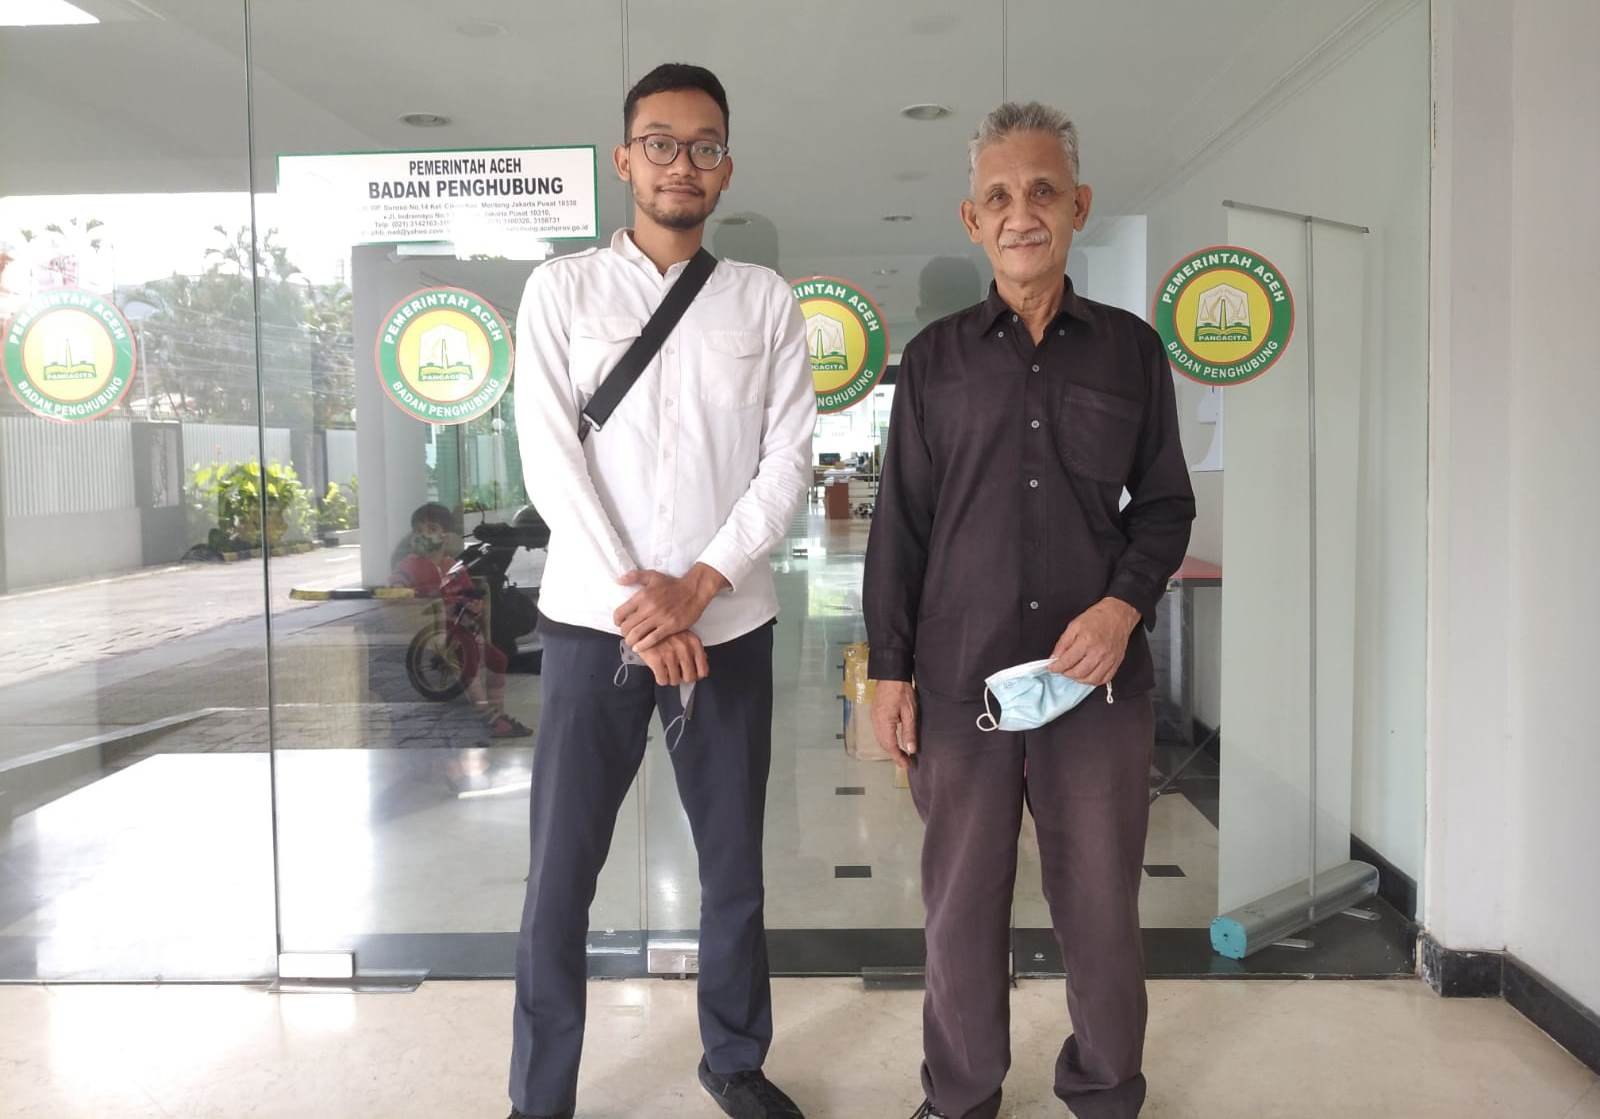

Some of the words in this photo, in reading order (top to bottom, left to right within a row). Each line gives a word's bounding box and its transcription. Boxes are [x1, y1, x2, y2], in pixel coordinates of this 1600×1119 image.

[409, 158, 487, 176] PEMERINTAH
[489, 157, 522, 174] ACEH
[368, 180, 431, 199] BADAN
[436, 177, 564, 197] PENGHUBUNG
[511, 200, 536, 208] Jakarta
[537, 199, 556, 208] Pusat
[1162, 253, 1252, 304] PEMERINTAH
[1254, 265, 1286, 302] ACEH
[93, 303, 126, 340] ACEH
[384, 293, 470, 345] PEMERINTAH
[470, 305, 503, 341] ACEH
[793, 283, 847, 299] INTAH
[848, 295, 880, 332] ACEH
[1167, 341, 1202, 373] BADAN
[1203, 340, 1279, 378] PENGHUBUNG
[18, 380, 53, 412] BADAN
[54, 377, 123, 416] PENGHUBUNG
[392, 380, 427, 412] BADAN
[428, 378, 499, 417] PENGHUBUNG
[816, 369, 874, 407] NGHUBUNG
